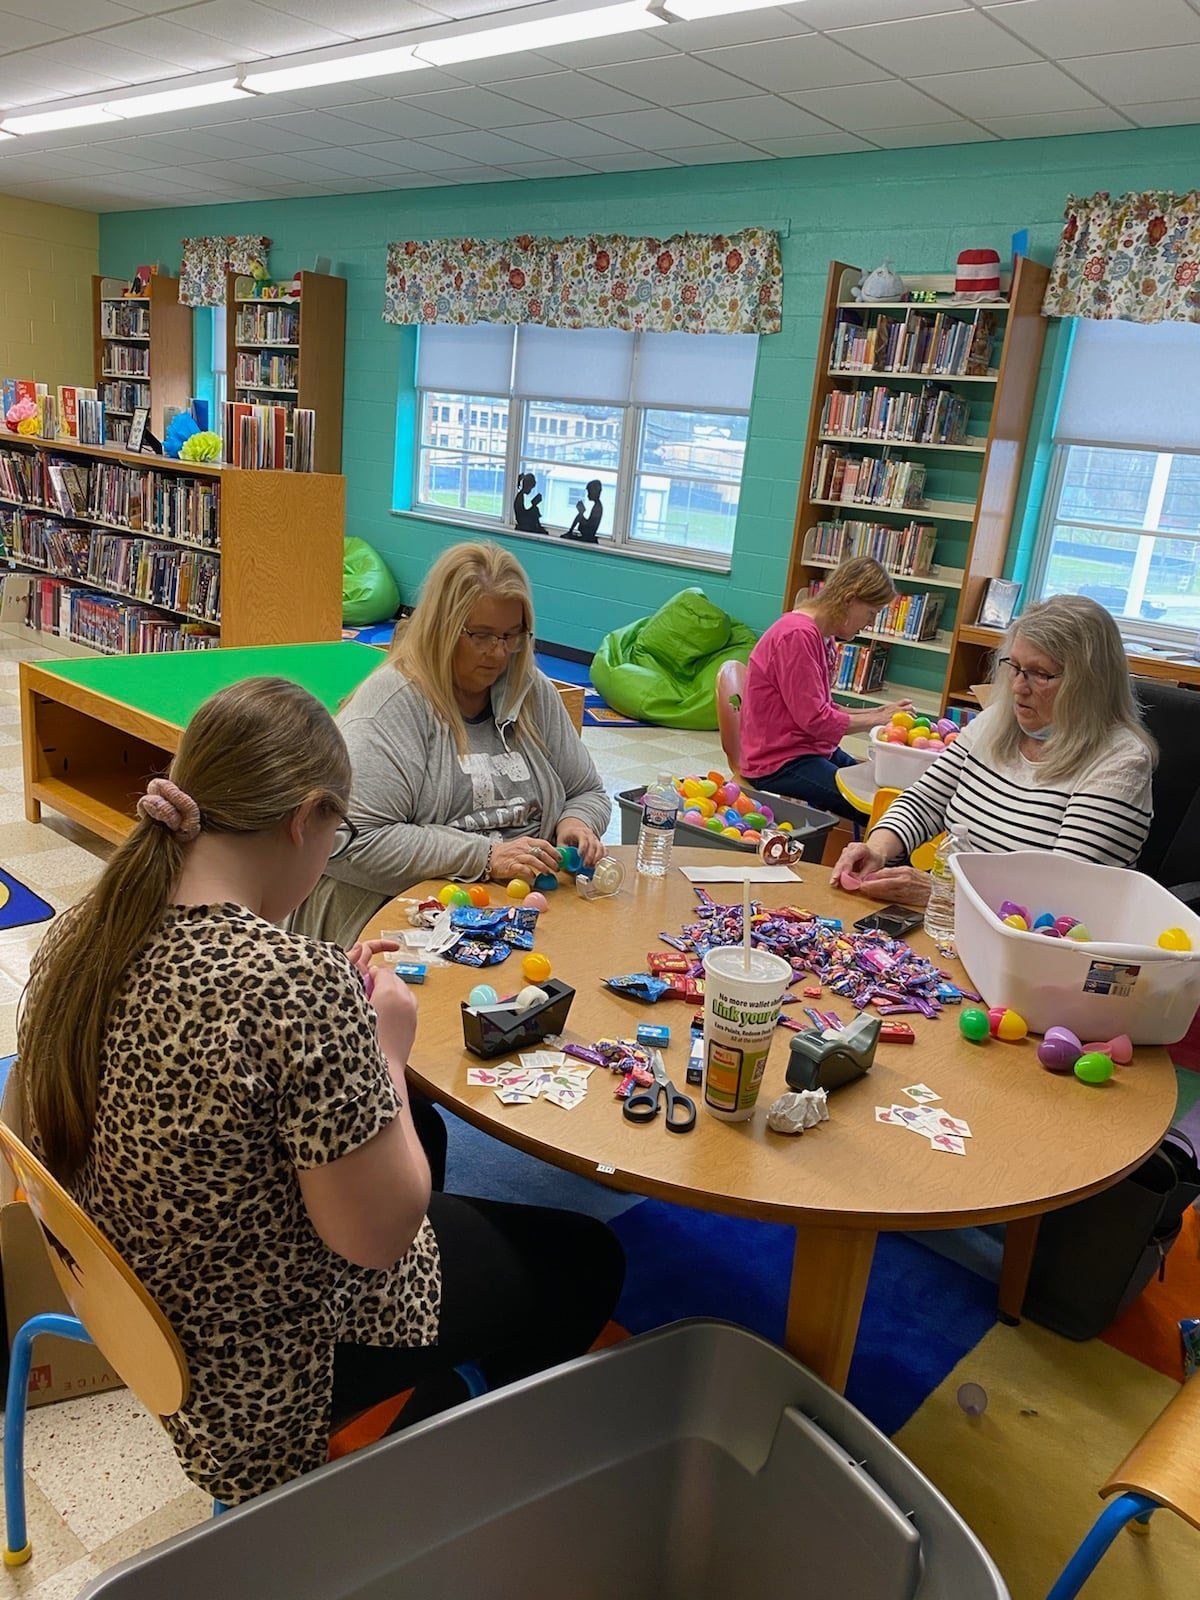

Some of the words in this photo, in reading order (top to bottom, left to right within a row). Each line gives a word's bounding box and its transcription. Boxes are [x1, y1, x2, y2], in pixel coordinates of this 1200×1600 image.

[911, 290, 937, 303] THE
[719, 993, 728, 1003] No
[729, 998, 748, 1008] more
[749, 1001, 771, 1009] wallet
[712, 998, 740, 1023] Link
[738, 1010, 772, 1028] your
